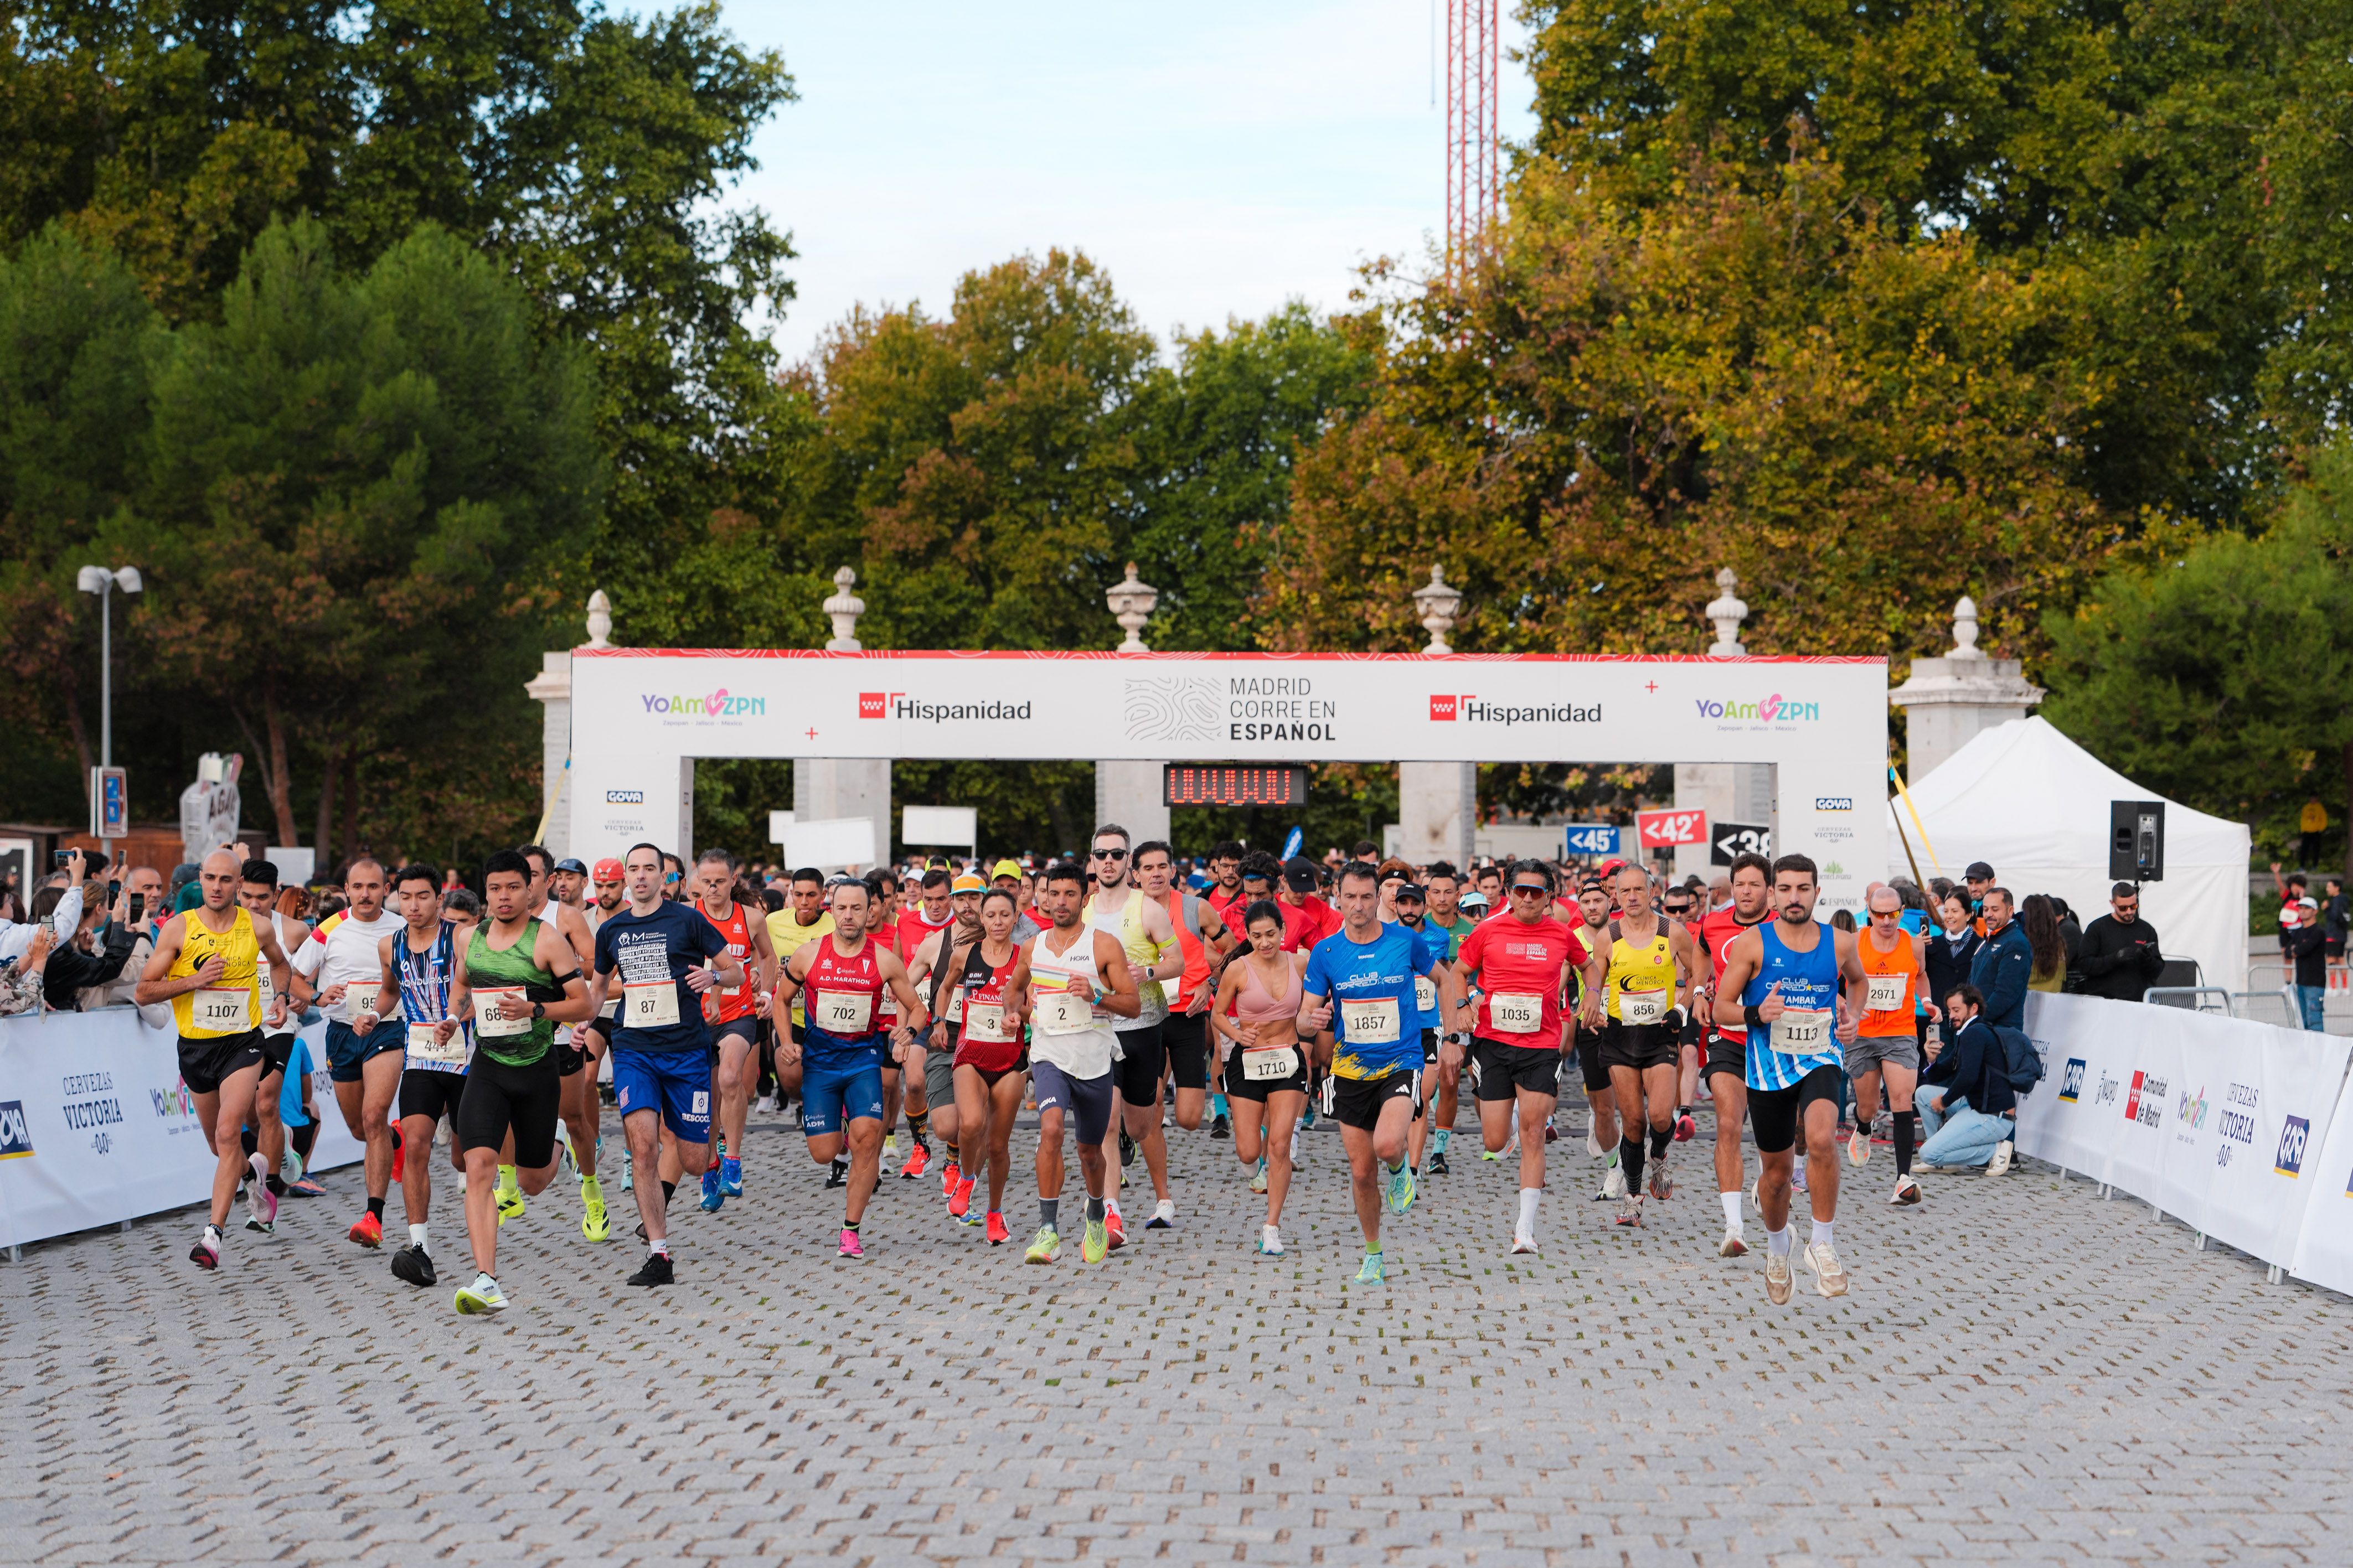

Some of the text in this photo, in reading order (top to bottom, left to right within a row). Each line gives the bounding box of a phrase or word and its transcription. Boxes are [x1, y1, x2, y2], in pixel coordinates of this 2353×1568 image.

[1231, 678, 1310, 696] MADRID
[897, 700, 1031, 723] Hispanidad
[1231, 700, 1335, 718] CORRE EN
[1468, 702, 1602, 726] Hispanidad
[1231, 720, 1335, 741] ESPAÑOL
[775, 934, 793, 942] marathon
[726, 943, 745, 956] RID
[399, 975, 450, 987] HONDURAS
[833, 976, 870, 985] MARATHON
[1349, 971, 1378, 980] CLUB
[1782, 977, 1808, 985] CLUB
[1335, 975, 1404, 991] CORREDRES
[1786, 996, 1817, 1005] AMBAR
[1871, 989, 1896, 1000] 2971
[207, 1005, 239, 1017] 1107
[641, 1000, 656, 1013] 87
[1633, 1004, 1654, 1015] 856
[833, 1007, 855, 1020] 702
[1058, 1008, 1066, 1020] 2
[1501, 1008, 1530, 1021] 1035
[1354, 1016, 1386, 1030] 1857
[1786, 1027, 1818, 1041] 1113
[1257, 1062, 1286, 1076] 1710
[63, 1072, 113, 1096] CERVEZAS
[2143, 1072, 2168, 1098] Comunidad
[1039, 1096, 1057, 1111] HOKA
[63, 1098, 123, 1130] VICTORIA
[2137, 1101, 2162, 1129] de Madrid
[0, 1109, 29, 1147] OYA
[807, 1120, 825, 1128] ADM
